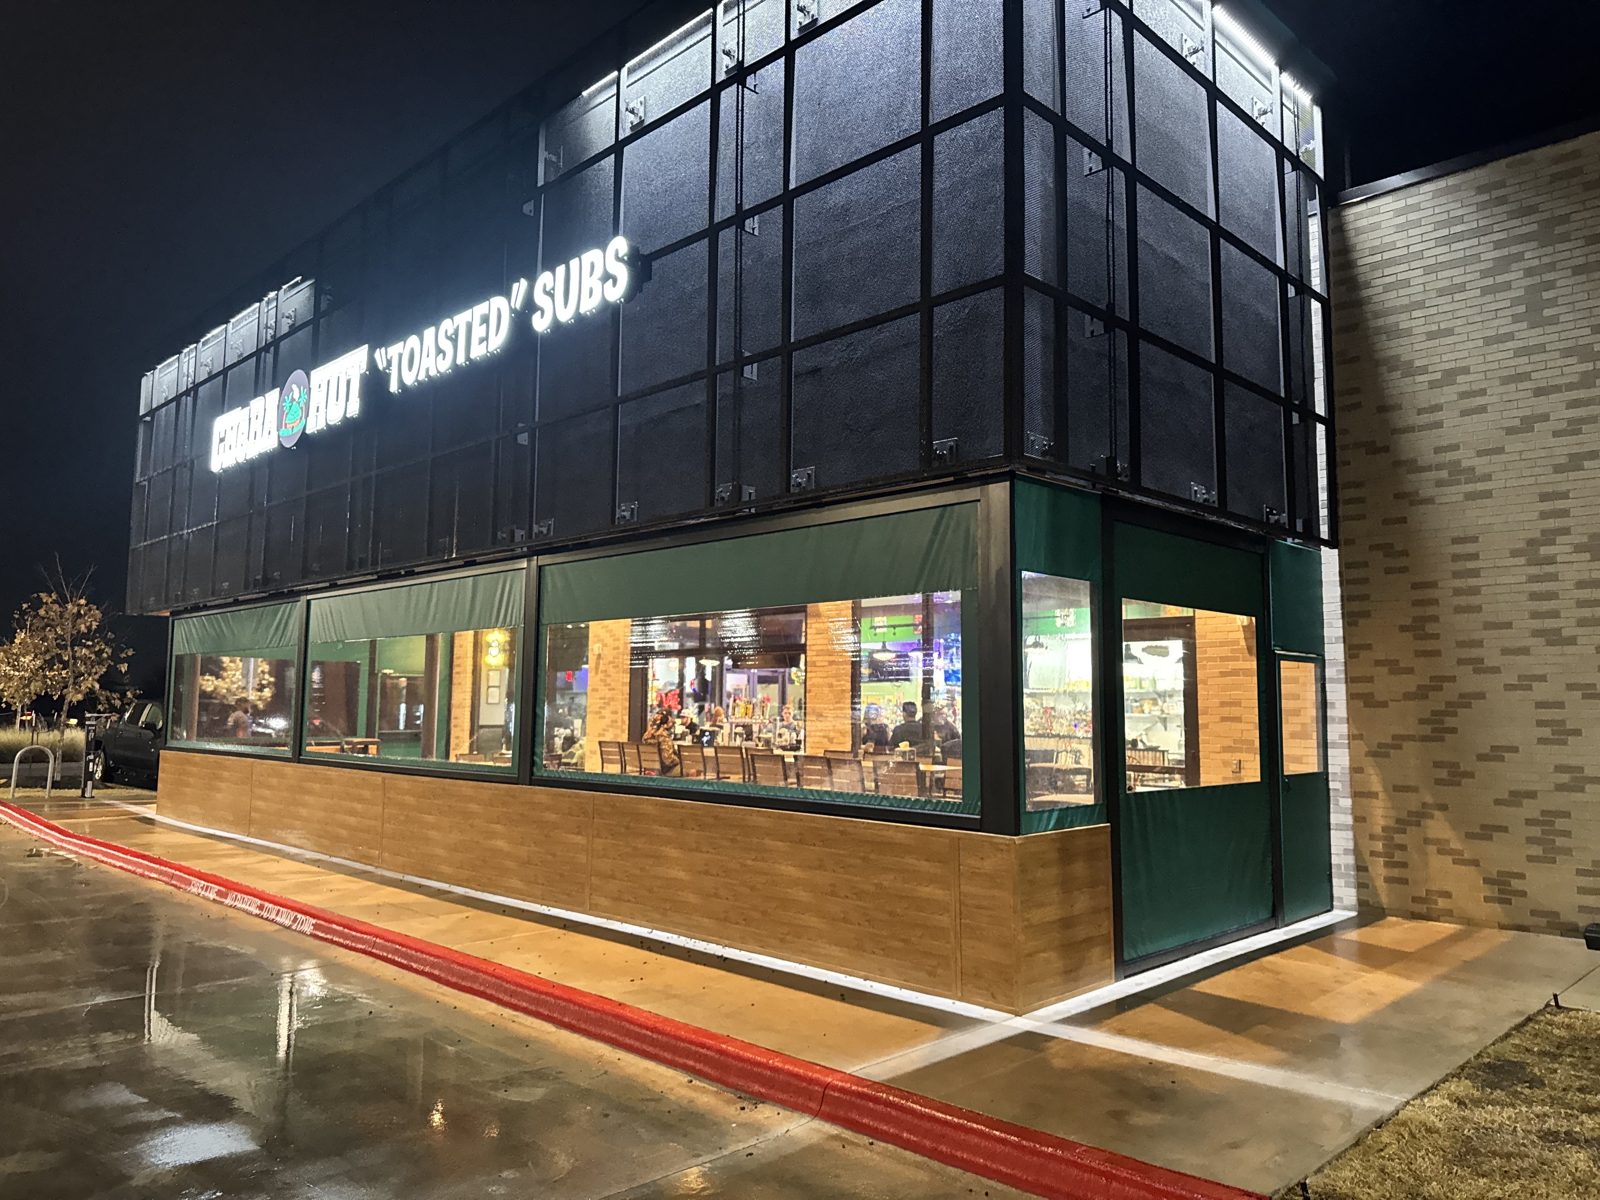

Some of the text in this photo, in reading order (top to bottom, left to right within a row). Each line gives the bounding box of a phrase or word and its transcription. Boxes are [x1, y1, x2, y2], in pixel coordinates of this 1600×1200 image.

[306, 344, 368, 434] HUT
[531, 235, 629, 333] SUBS
[260, 904, 278, 921] TOW
[274, 908, 295, 928] AWAY
[292, 915, 316, 935] ZONE
